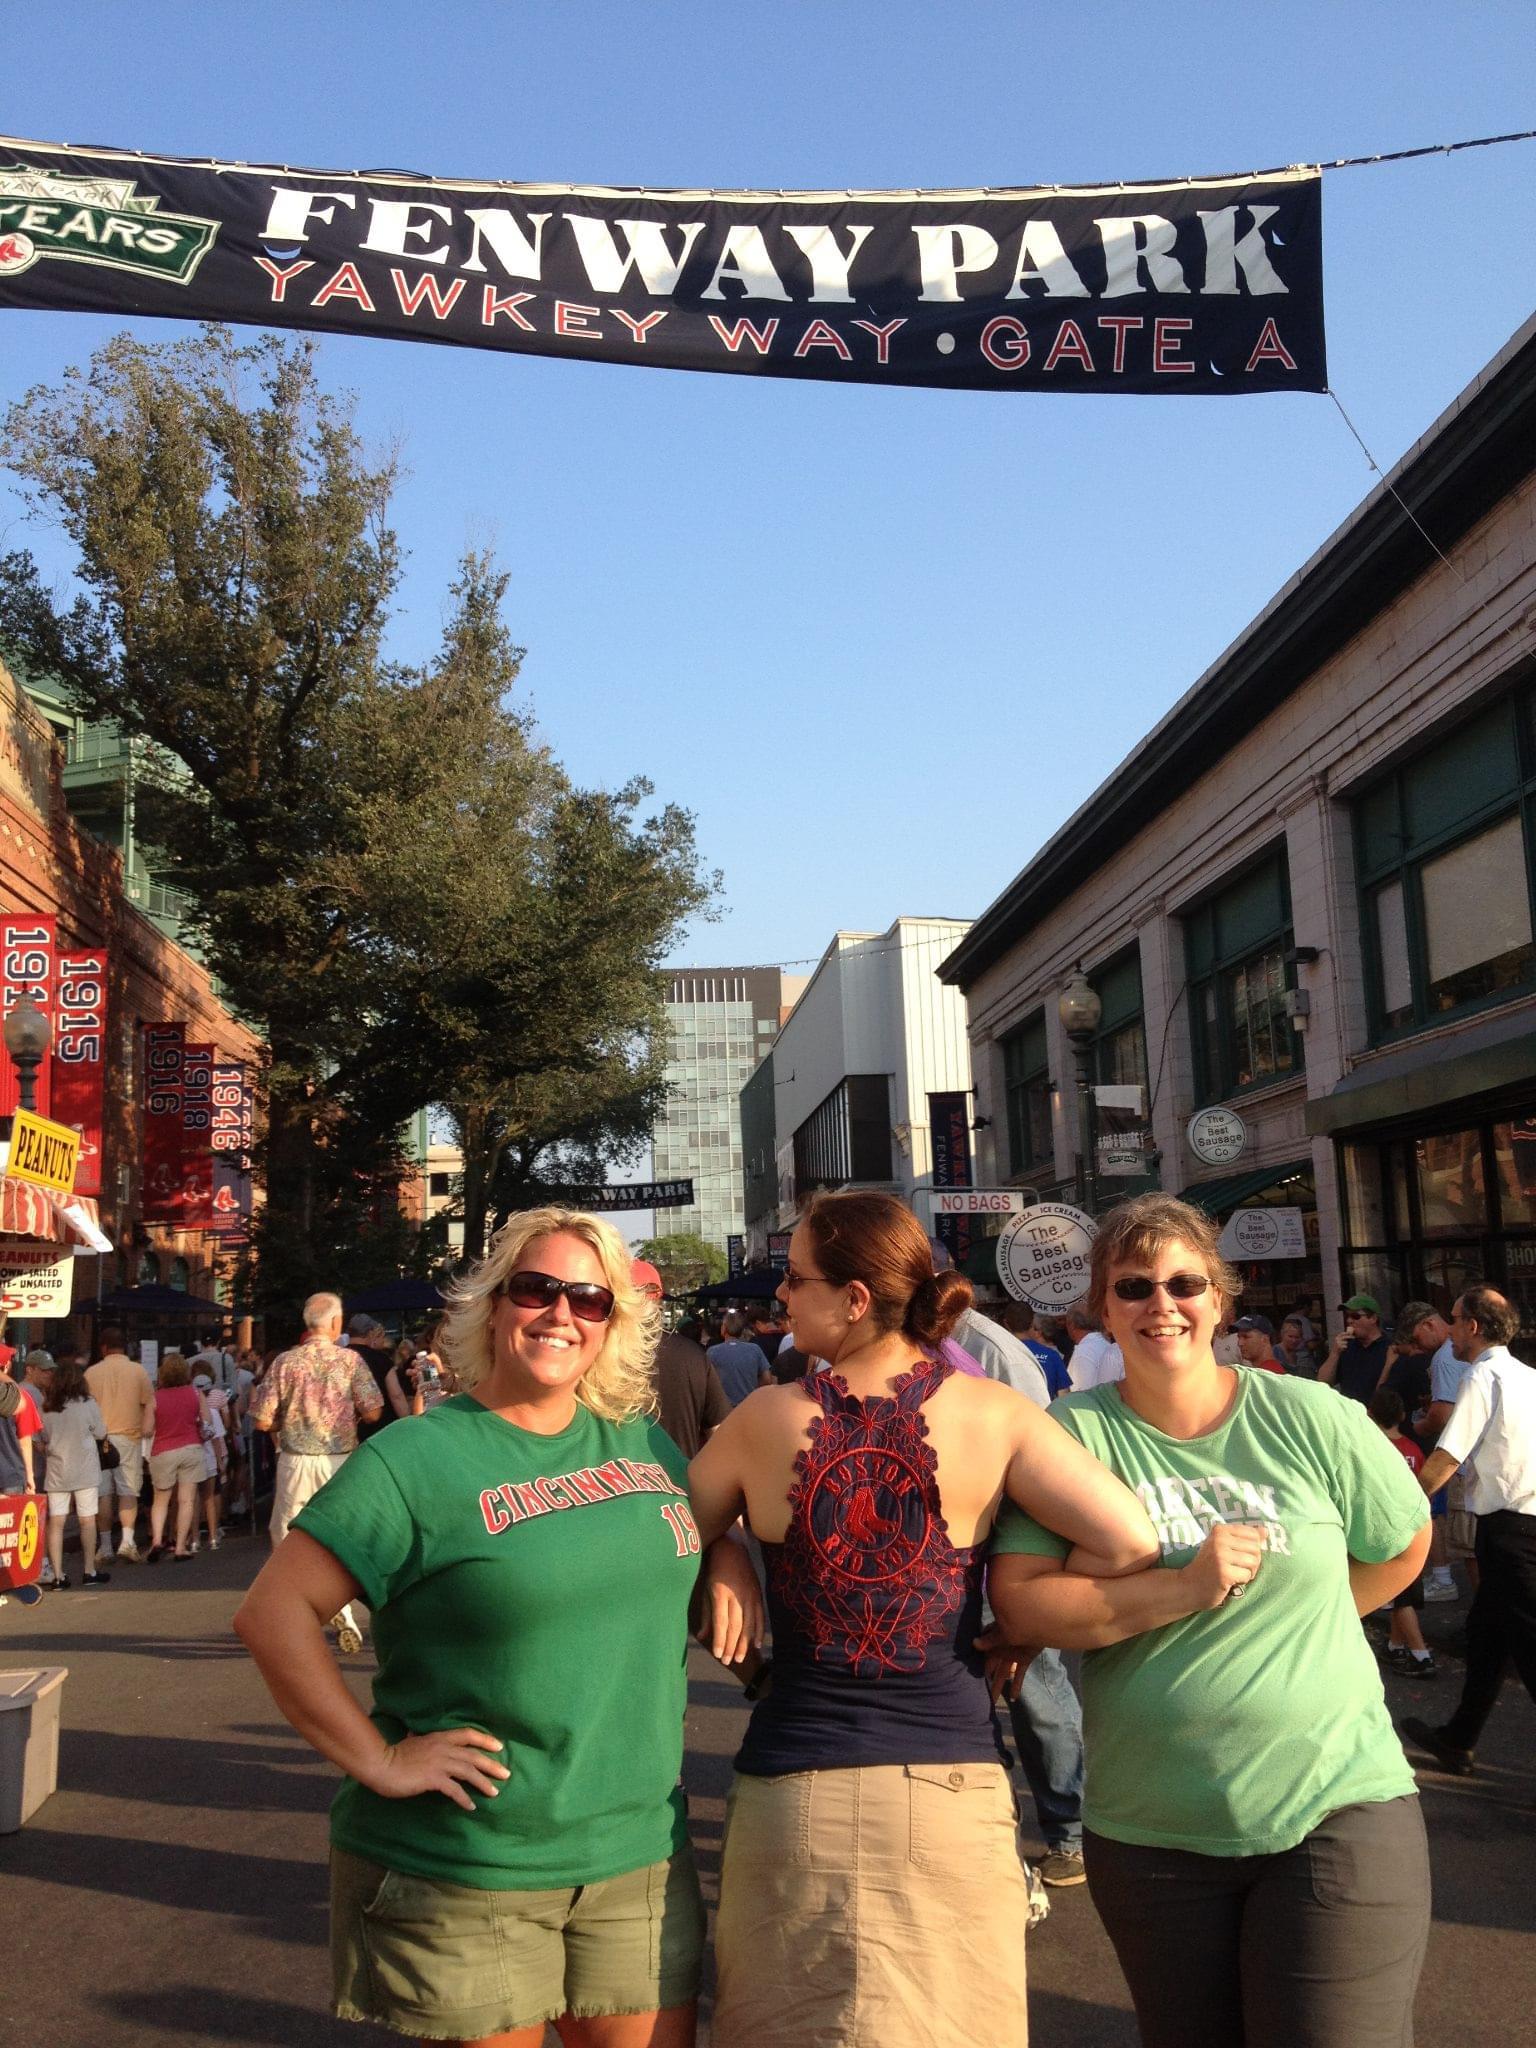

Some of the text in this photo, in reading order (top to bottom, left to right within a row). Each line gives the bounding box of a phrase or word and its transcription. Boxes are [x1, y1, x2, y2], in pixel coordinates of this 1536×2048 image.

[51, 185, 112, 200] PARK
[257, 186, 1290, 302] FENWAY PARK
[252, 256, 1298, 373] YAWKEY WAY GATE A
[4, 927, 50, 1018] 191
[59, 959, 101, 1063] 1915
[150, 1030, 181, 1115] 1916
[183, 1050, 211, 1130] 1918
[211, 1070, 242, 1150] 1946
[1206, 1114, 1224, 1123] The
[1197, 1134, 1242, 1146] Sausage
[1207, 1126, 1229, 1136] Best
[14, 1125, 75, 1183] PEANUTS
[936, 1135, 949, 1190] FENWA
[1214, 1148, 1229, 1157] Co
[642, 1183, 689, 1199] PARK
[941, 1194, 1011, 1211] NO BAGS
[1000, 1234, 1011, 1271] SAUSAGE
[1011, 1211, 1032, 1229] PIZZA
[1054, 1206, 1081, 1221] CREAM
[1027, 1225, 1058, 1241] The
[1239, 1232, 1276, 1240] Sausage
[1247, 1224, 1266, 1232] Best
[1032, 1241, 1068, 1262] Best
[1506, 1246, 1536, 1266] BHO
[1019, 1252, 1091, 1283] Sausage
[20, 1279, 63, 1289] UNSALTED
[825, 1455, 913, 1496] BOSTON
[661, 1502, 700, 1557] 19
